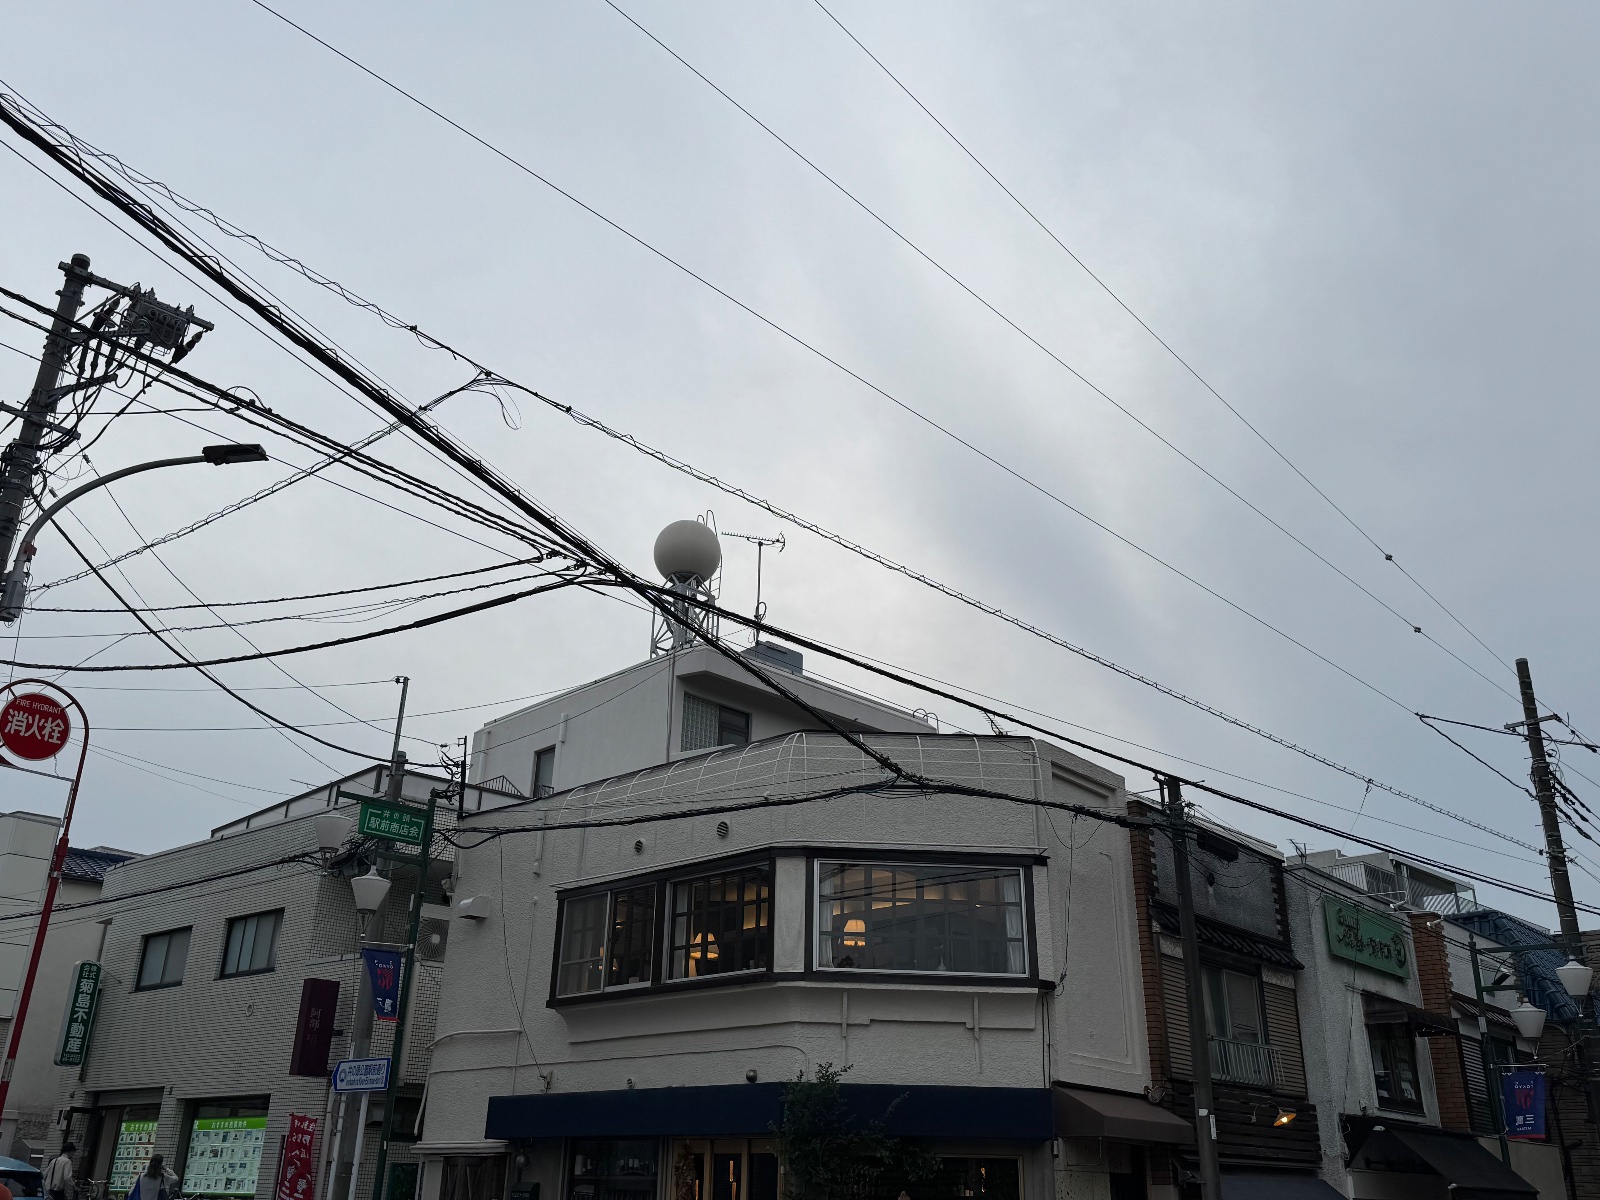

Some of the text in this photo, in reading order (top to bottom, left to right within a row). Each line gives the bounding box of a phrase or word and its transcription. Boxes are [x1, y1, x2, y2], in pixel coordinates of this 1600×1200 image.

[16, 698, 62, 715] FIRE HYDRANT
[4, 708, 65, 744] 消火栓
[368, 816, 419, 838] 駅前商店会
[382, 809, 411, 823] 井の頭
[66, 978, 95, 1053] 菊島不動産
